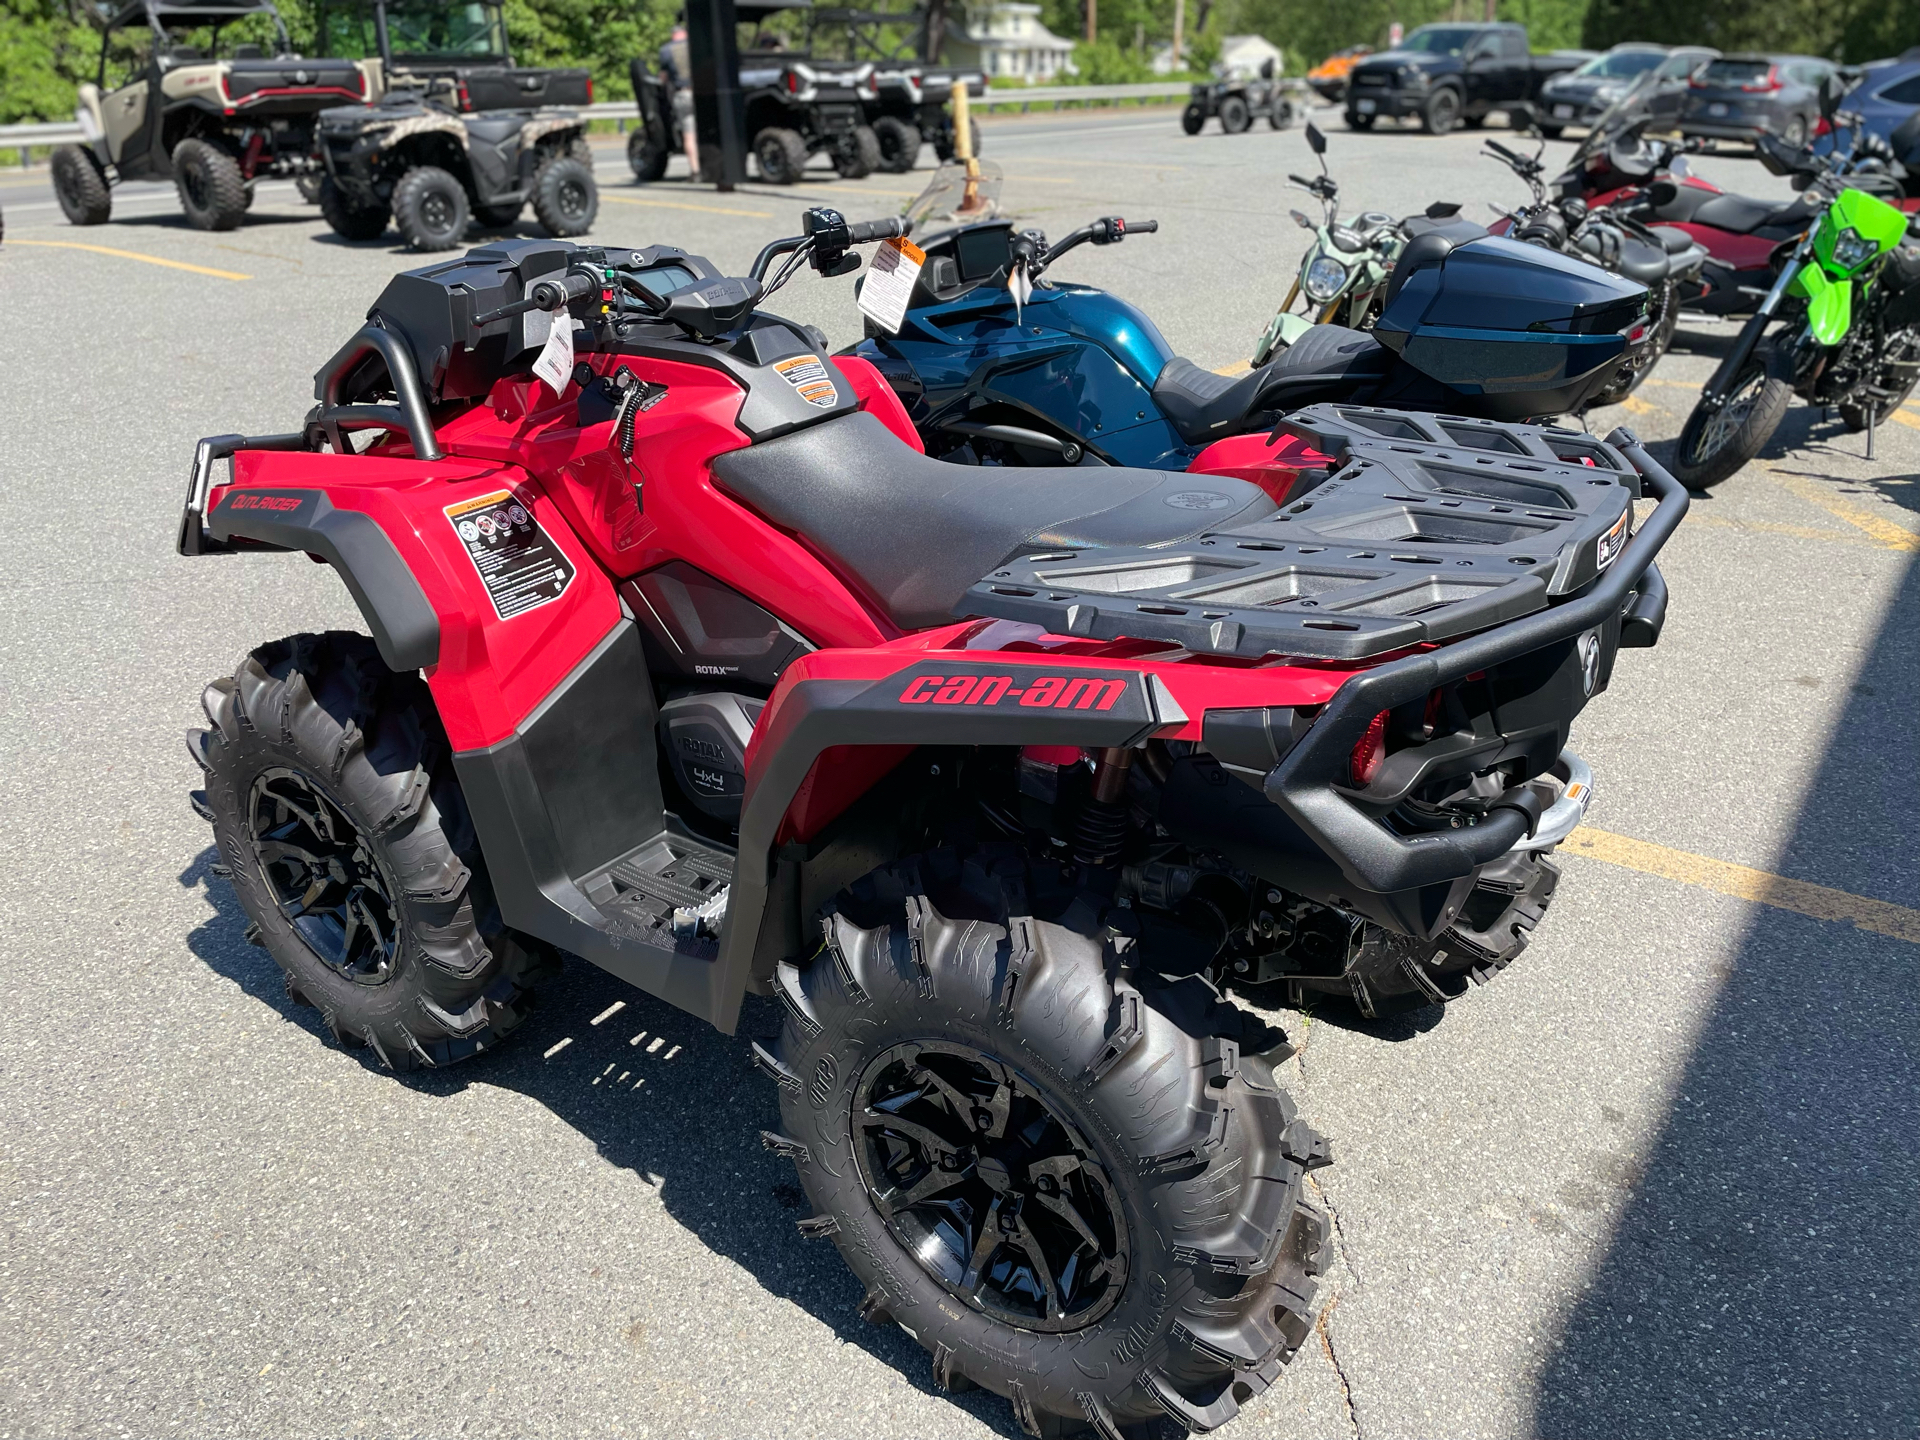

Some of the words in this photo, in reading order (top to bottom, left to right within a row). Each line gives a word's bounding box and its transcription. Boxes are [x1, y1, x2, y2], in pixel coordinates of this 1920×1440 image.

[230, 494, 303, 511] OUTLANDER
[695, 665, 727, 675] ROTAX
[898, 676, 1127, 710] can-am
[683, 737, 725, 759] ROTAX
[693, 767, 724, 785] 4x4
